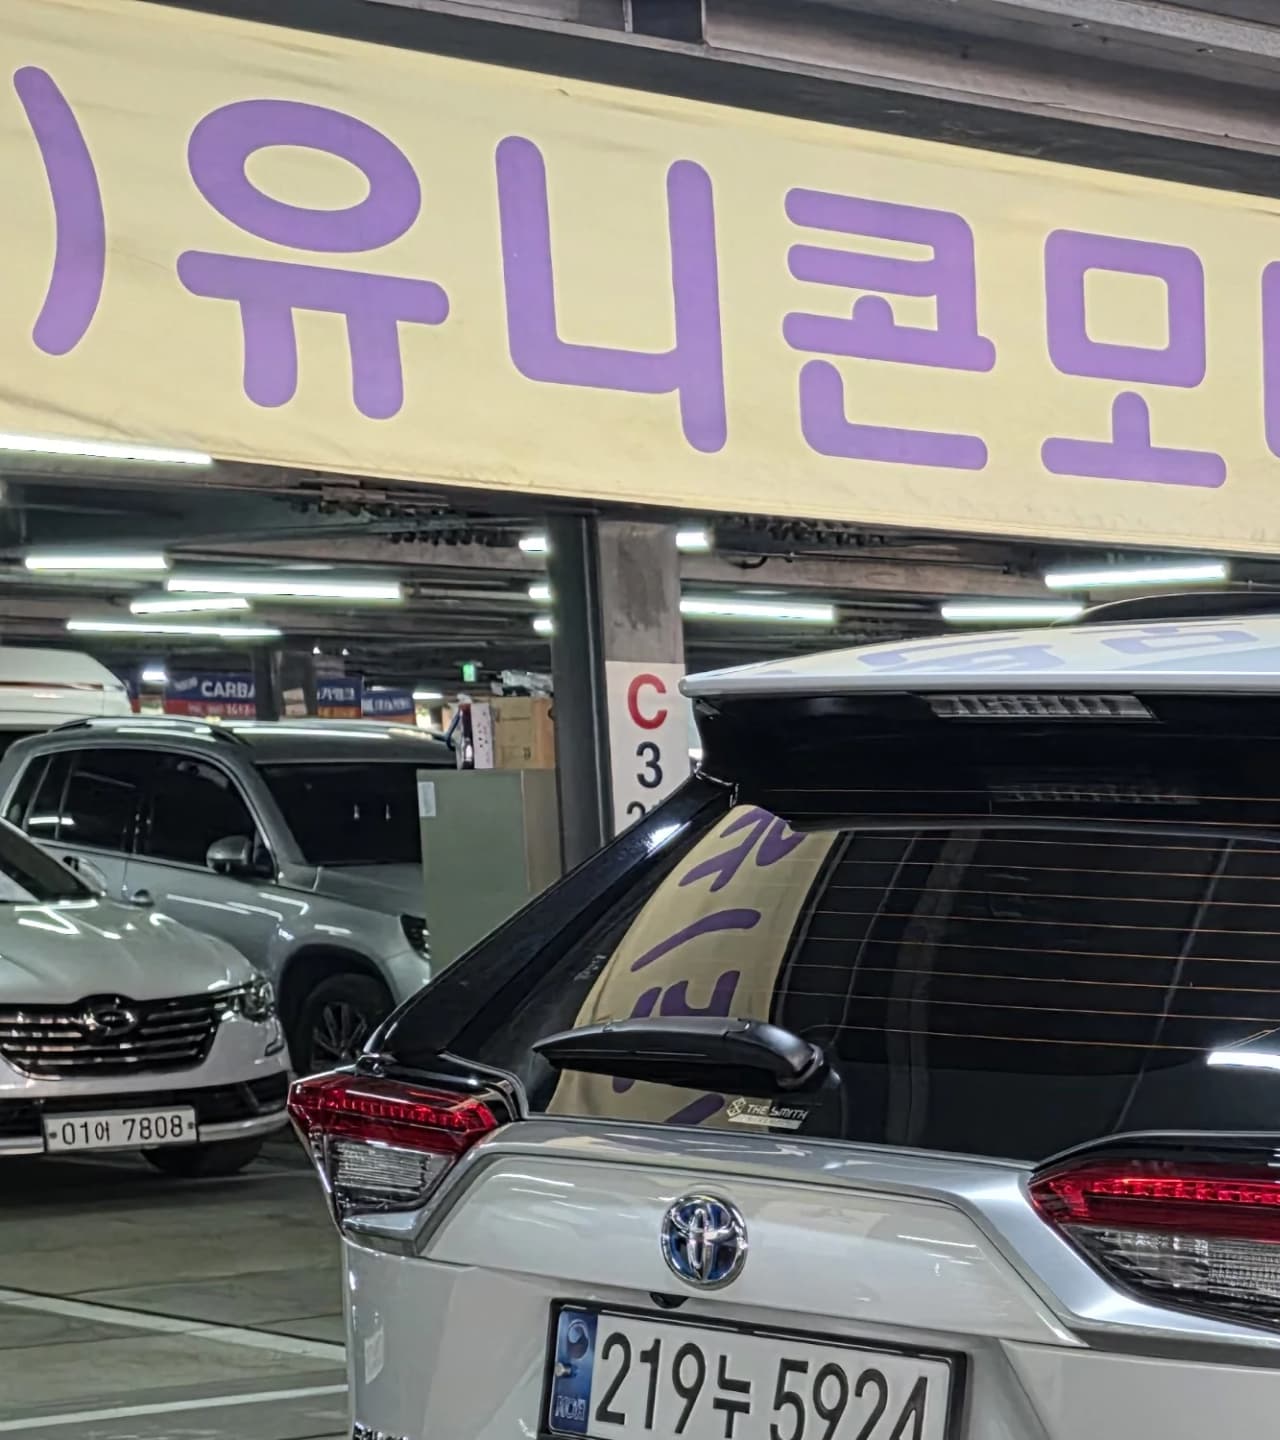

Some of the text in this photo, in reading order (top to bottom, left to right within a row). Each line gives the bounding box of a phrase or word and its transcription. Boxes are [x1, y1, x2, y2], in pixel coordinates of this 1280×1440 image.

[627, 673, 668, 730] C
[636, 741, 663, 789] 3
[122, 1114, 184, 1142] 7808
[747, 1104, 769, 1115] THE
[594, 1331, 752, 1439] 219누
